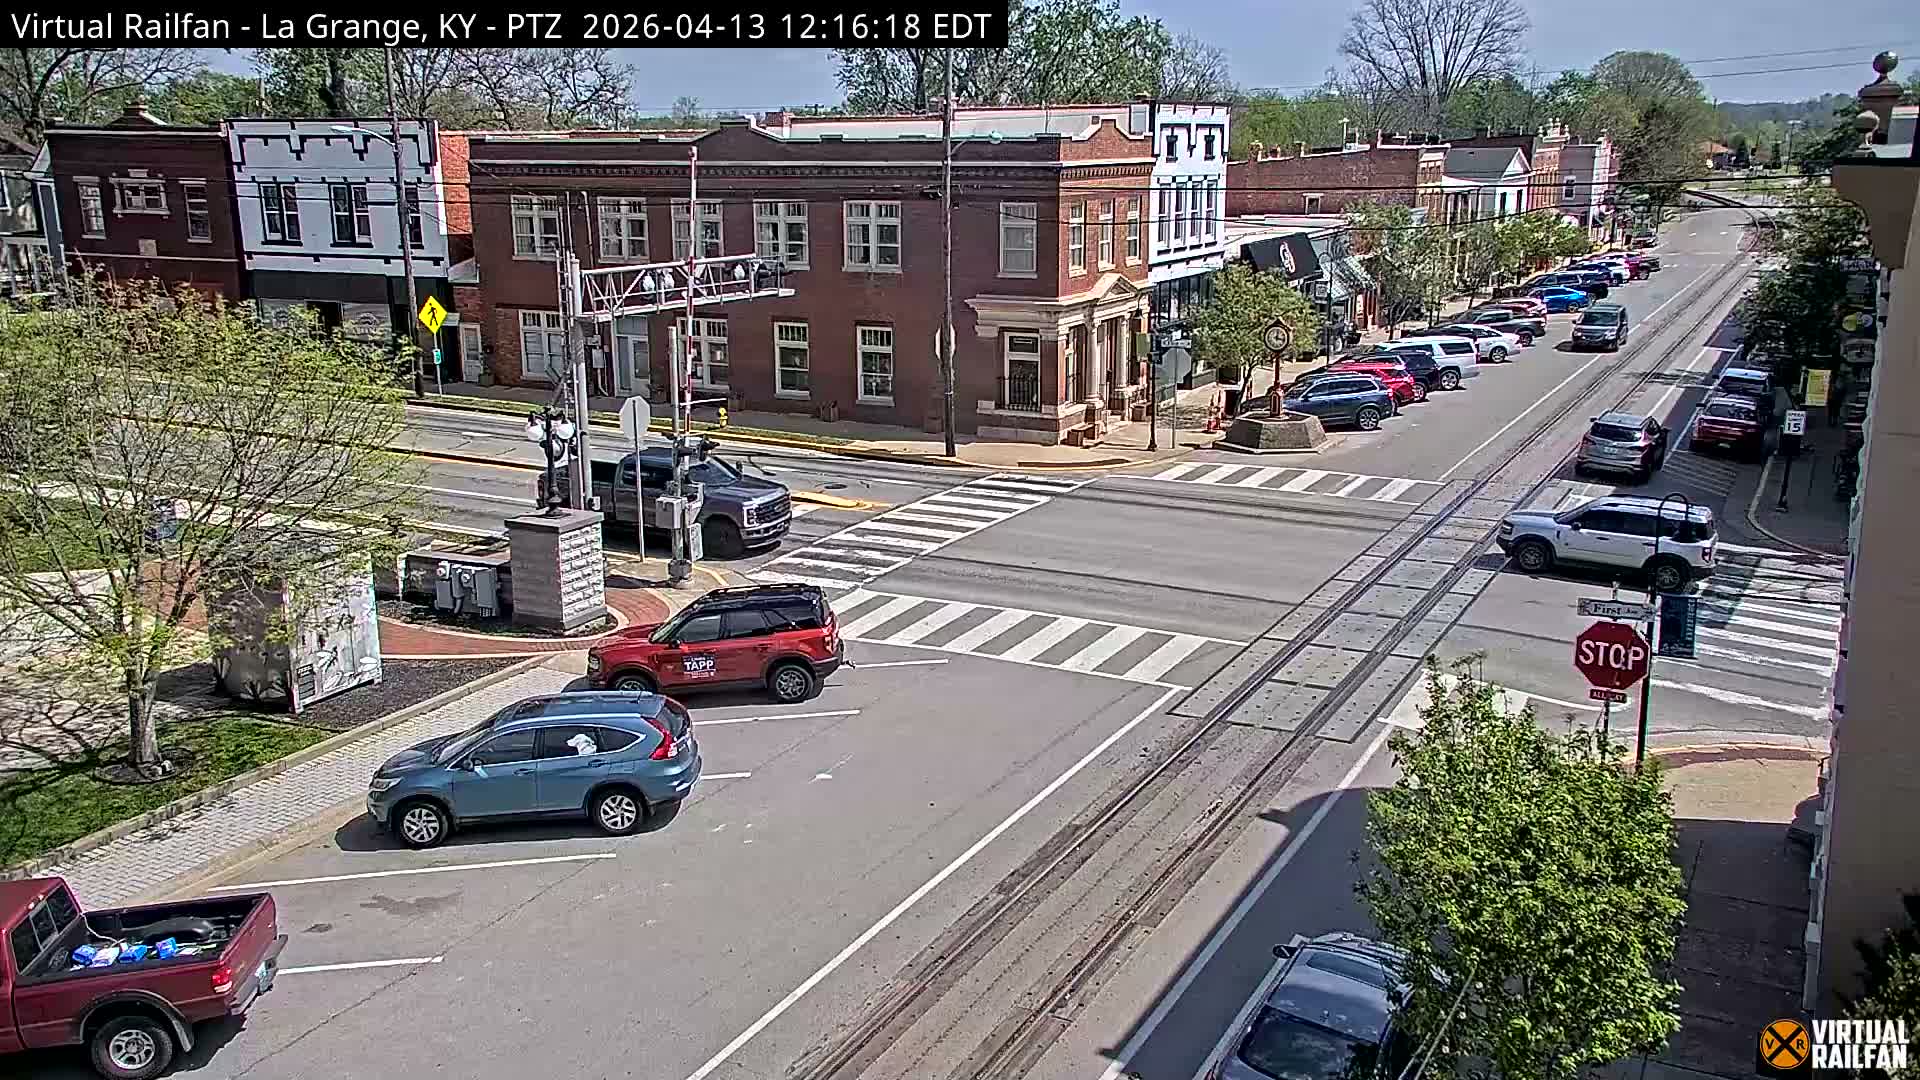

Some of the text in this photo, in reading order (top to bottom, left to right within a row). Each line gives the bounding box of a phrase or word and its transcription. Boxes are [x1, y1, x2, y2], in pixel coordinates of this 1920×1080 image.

[1787, 422, 1801, 432] 15
[1593, 603, 1621, 615] First
[1579, 640, 1644, 670] STOP
[684, 660, 714, 671] TAPP
